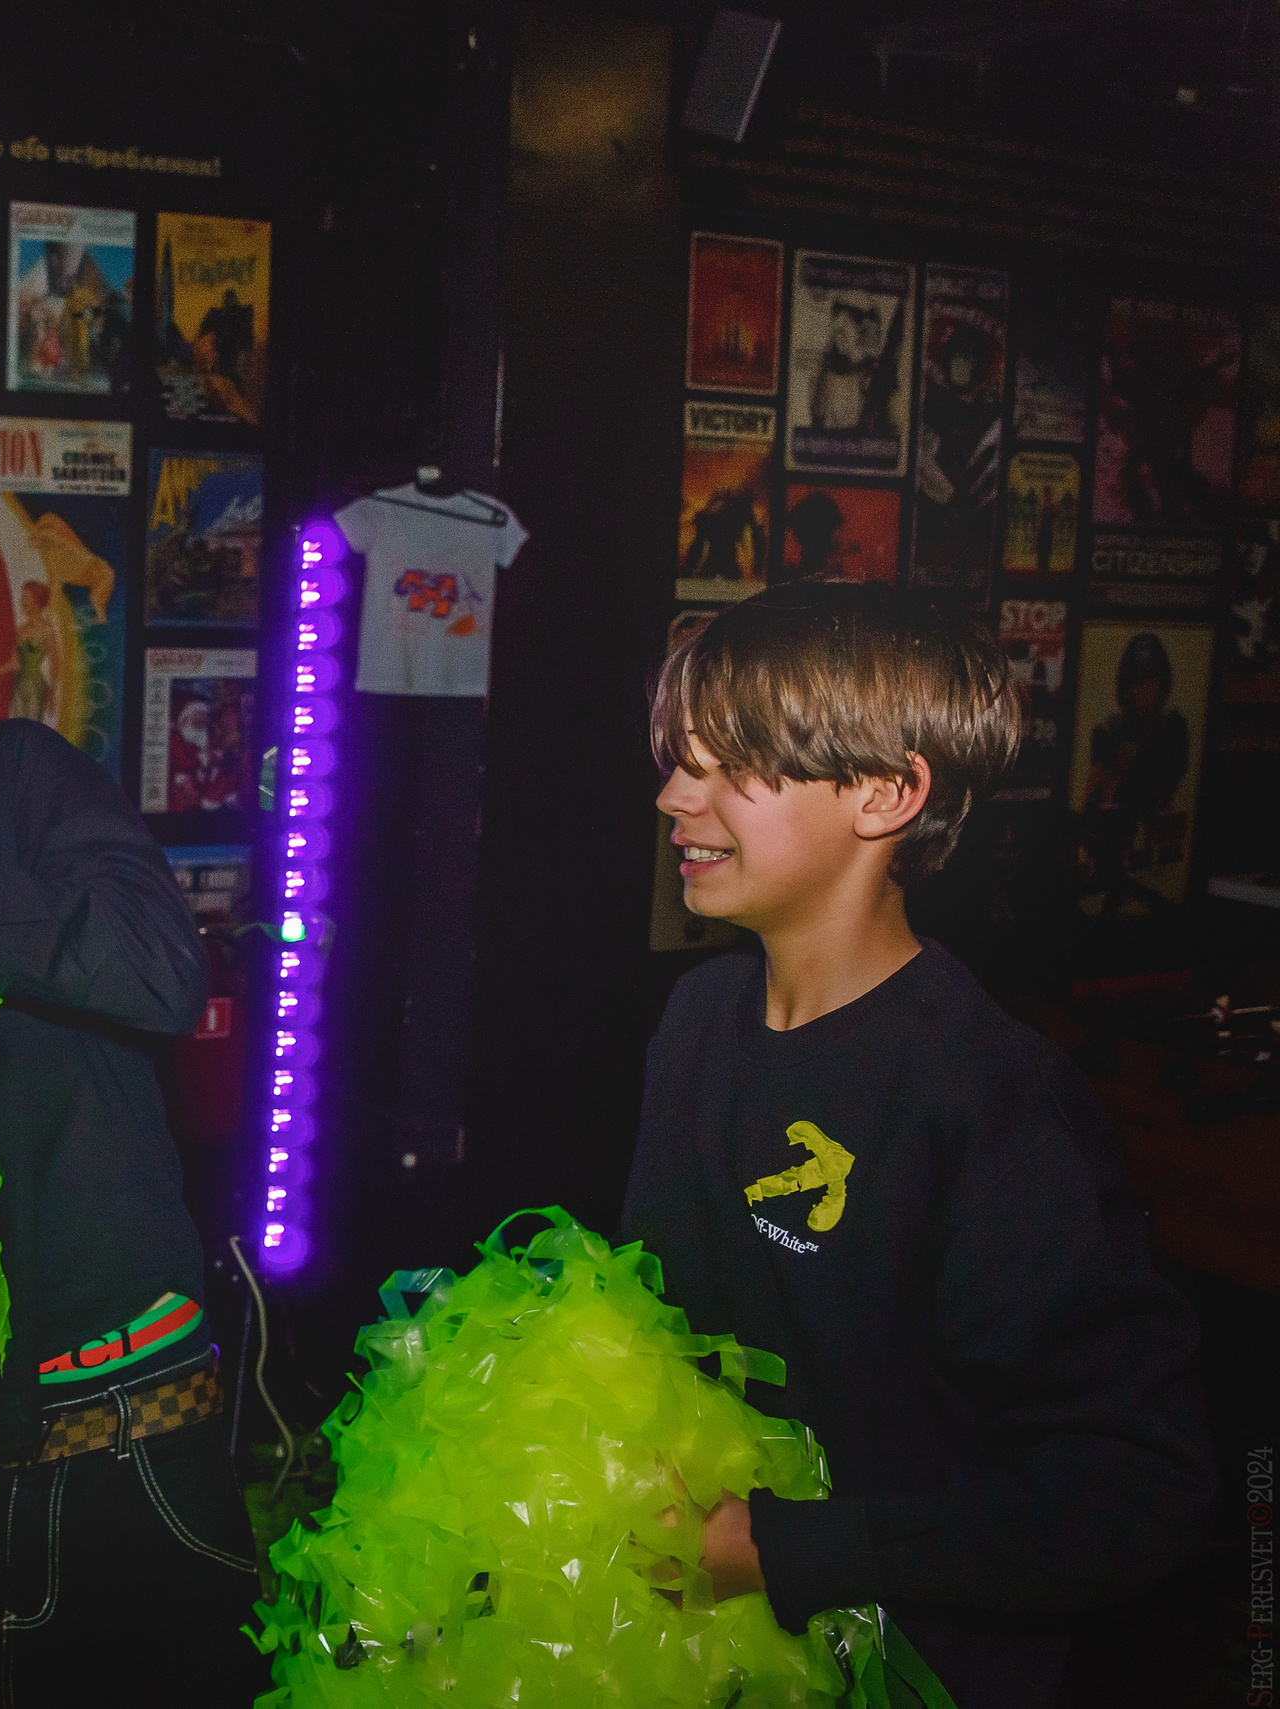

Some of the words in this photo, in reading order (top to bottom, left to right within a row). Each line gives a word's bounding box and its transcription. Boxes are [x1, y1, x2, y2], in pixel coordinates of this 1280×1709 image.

[9, 135, 50, 163] его
[690, 406, 772, 435] VICTORY
[1090, 549, 1223, 578] CITIZENSHIP
[1000, 600, 1068, 632] STOP
